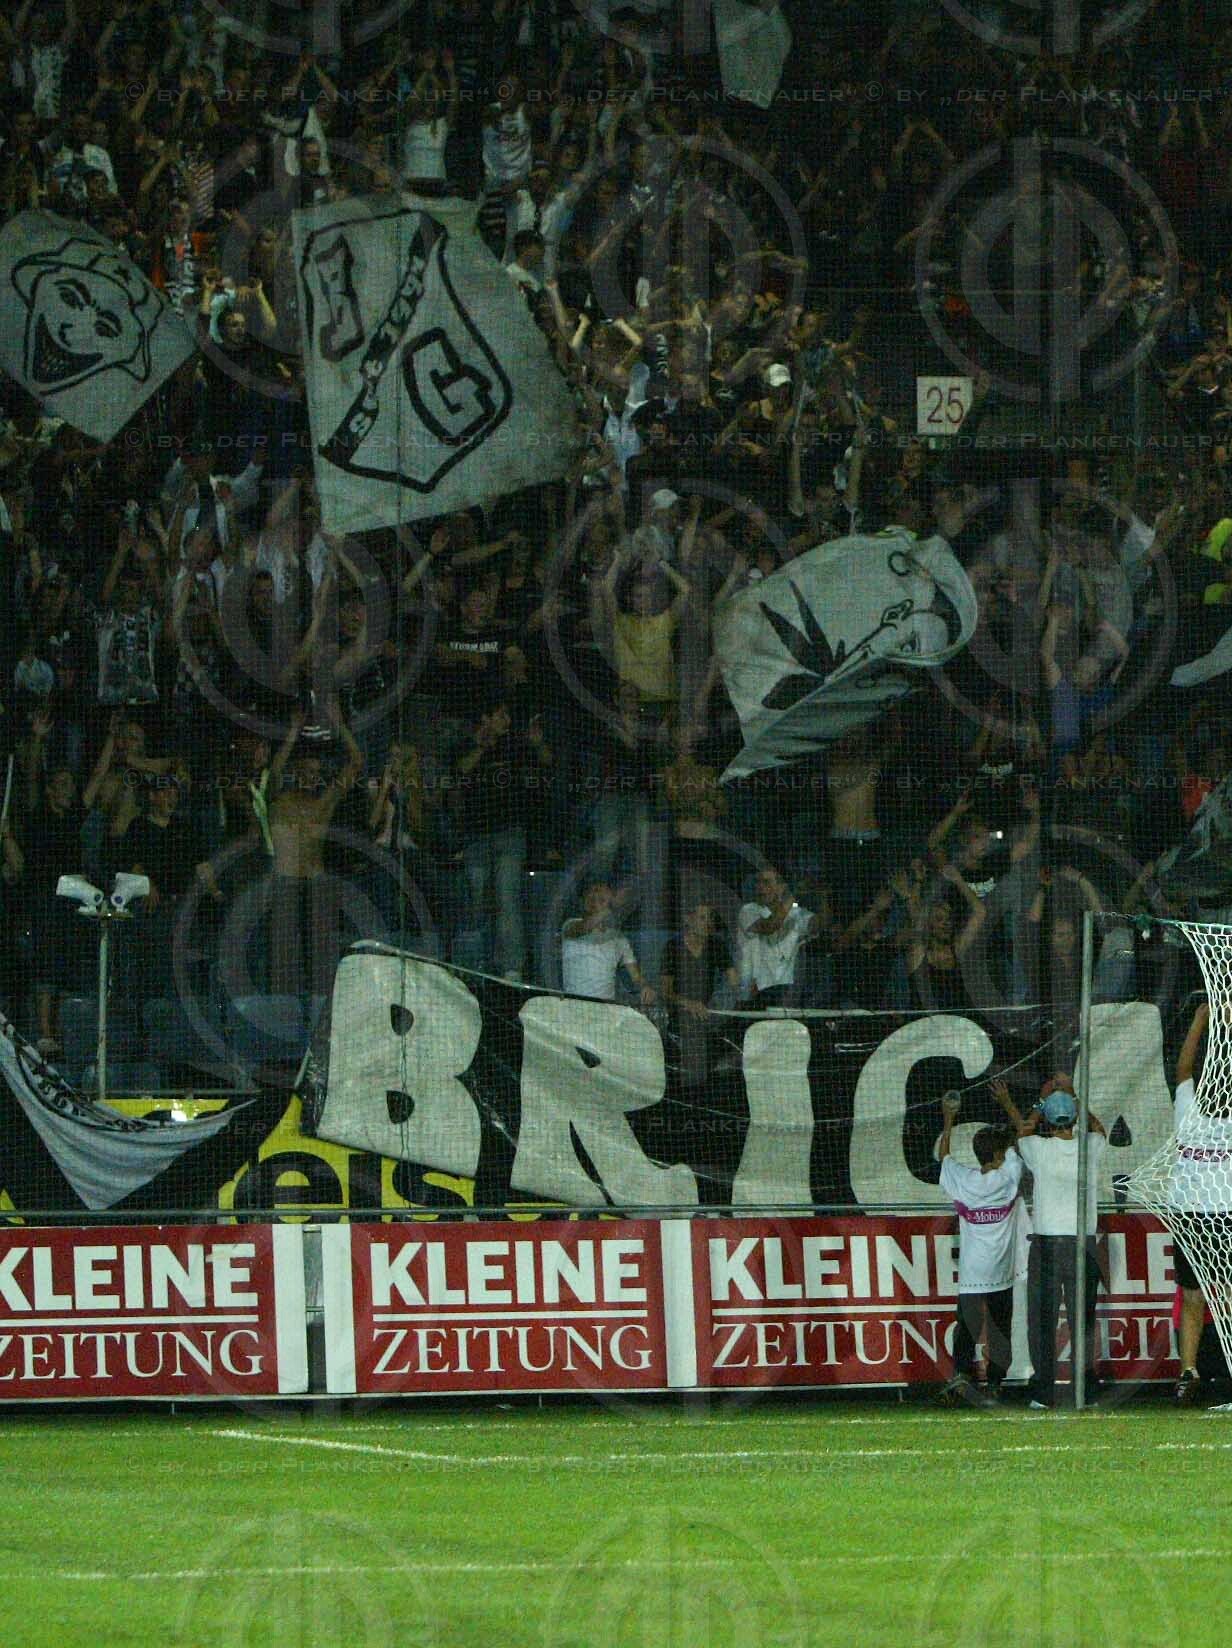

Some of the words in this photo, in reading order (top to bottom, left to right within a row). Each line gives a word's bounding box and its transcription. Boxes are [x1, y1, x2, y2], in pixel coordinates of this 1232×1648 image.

[926, 386, 964, 423] 25
[0, 1243, 259, 1312] KLEINE
[371, 1238, 647, 1307] KLEINE
[372, 1323, 653, 1375] ZEITUNG
